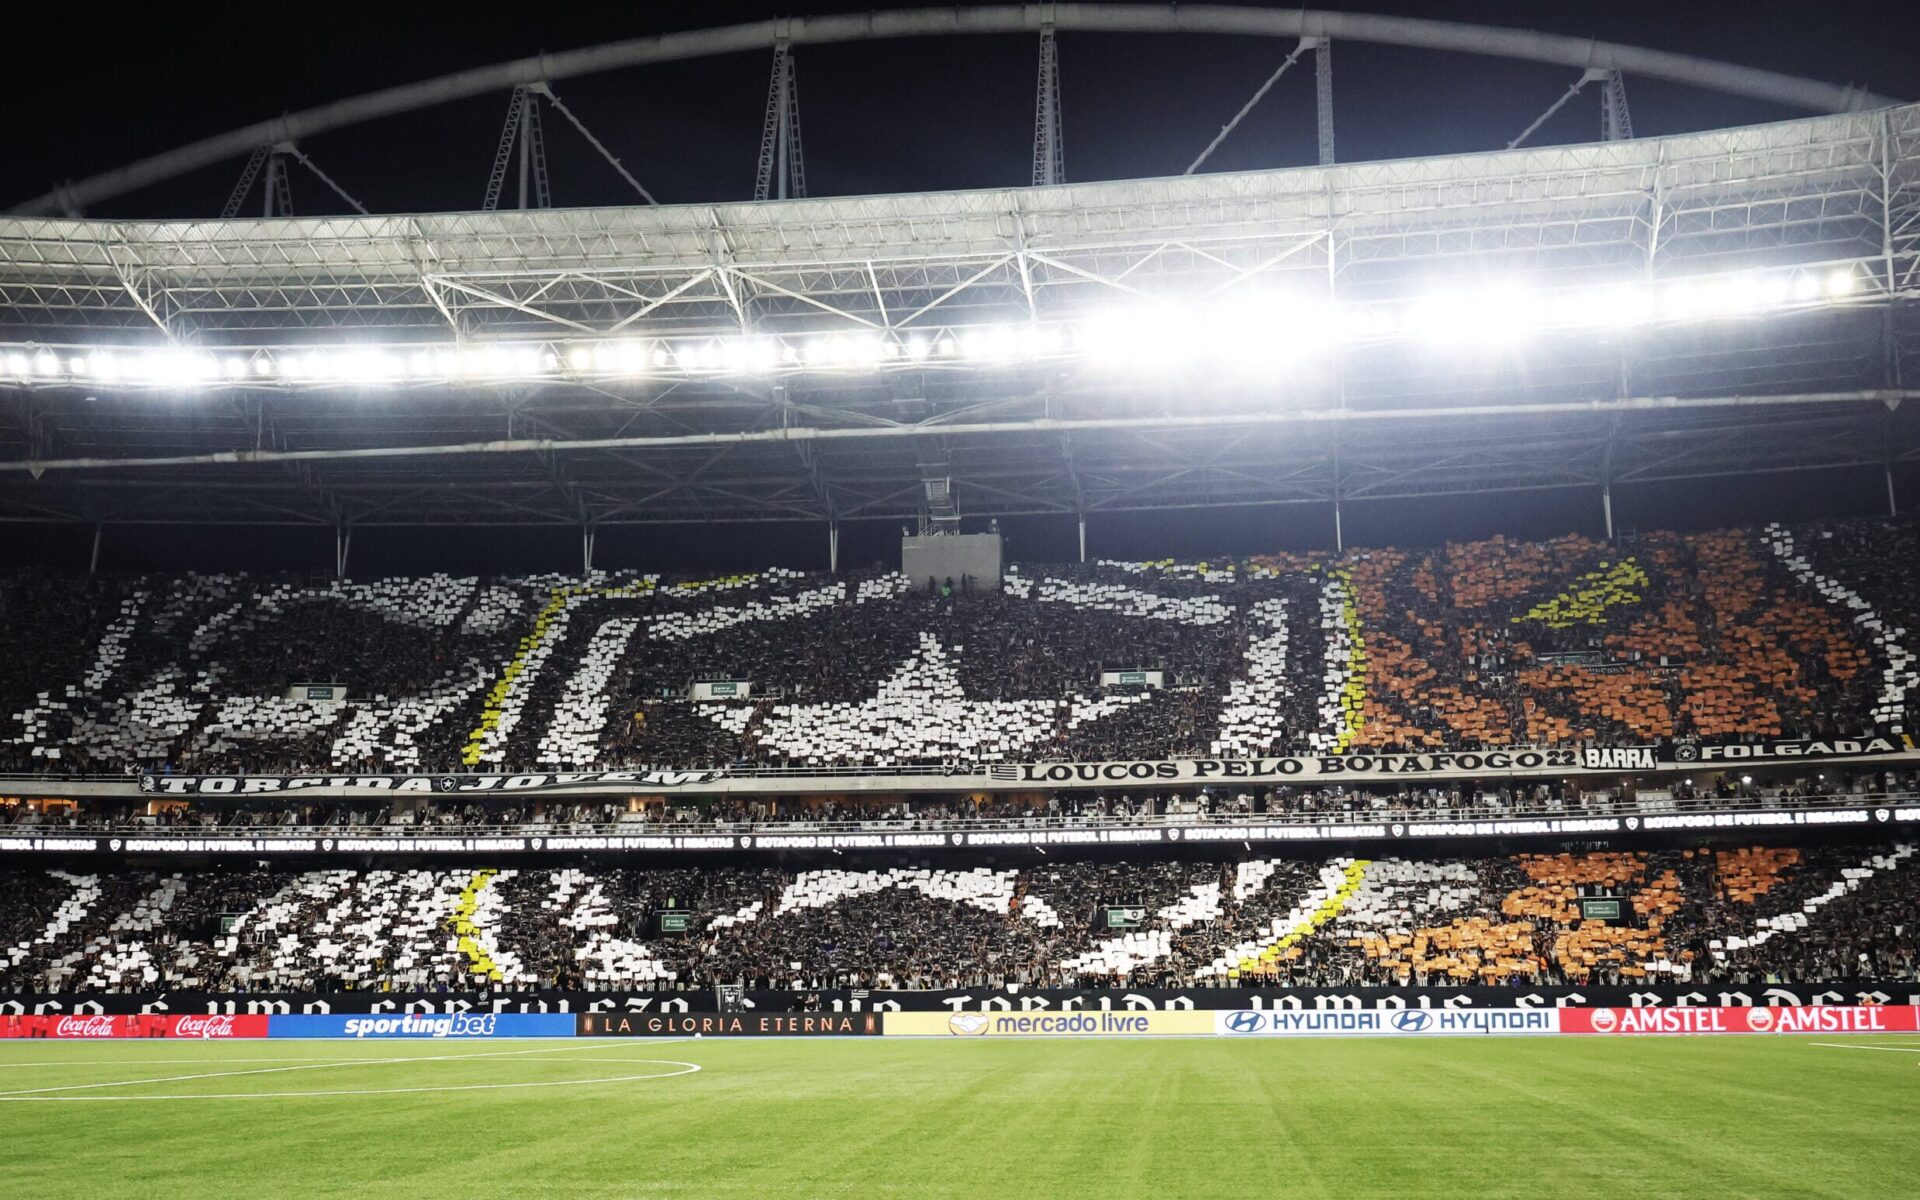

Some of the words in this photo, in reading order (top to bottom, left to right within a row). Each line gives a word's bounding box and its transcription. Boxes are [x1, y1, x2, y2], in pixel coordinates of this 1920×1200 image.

[1586, 748, 1655, 768] BARRA
[1702, 739, 1895, 759] FOLGADA
[1021, 763, 1179, 781] LOUCOS
[1192, 758, 1303, 777] PELO
[1318, 752, 1544, 774] BOTAFOGO
[57, 1015, 113, 1036] Coca-Cola
[175, 1014, 234, 1036] Coca-Cola
[344, 1011, 496, 1037] sportingbet
[605, 1018, 631, 1032] LA
[648, 1017, 743, 1032] GLORIA
[761, 1016, 853, 1032] ETERNA
[996, 1011, 1096, 1032] mercado
[1102, 1011, 1149, 1032] livre
[1274, 1013, 1380, 1029] HYUNDAI
[1440, 1012, 1549, 1028] HYUNDAI
[1620, 1008, 1726, 1031] AMSTEL
[1776, 1006, 1885, 1030] AMSTEL
